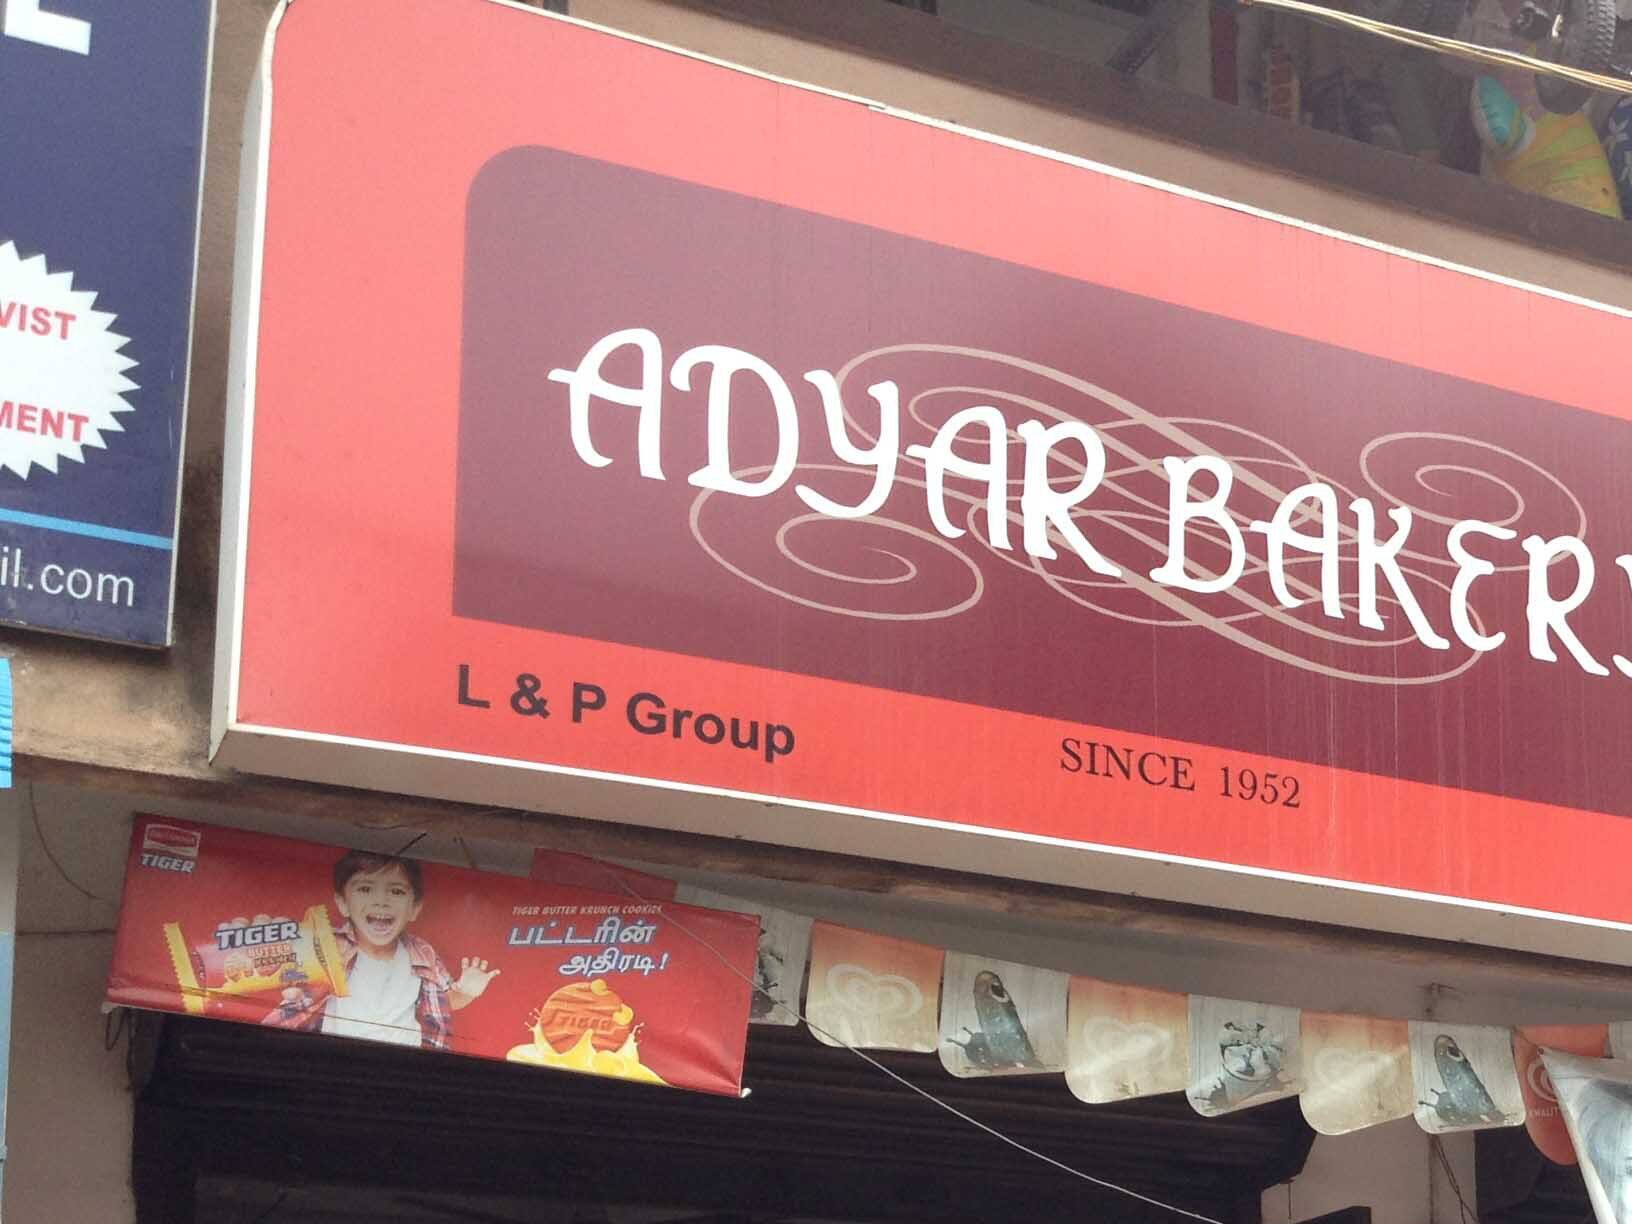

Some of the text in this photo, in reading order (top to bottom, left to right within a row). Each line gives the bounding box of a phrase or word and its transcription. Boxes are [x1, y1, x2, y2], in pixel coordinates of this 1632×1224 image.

[548, 328, 1122, 579] ADYAR
[457, 664, 796, 763] L & P Group
[1060, 738, 1302, 810] SINCE 1952
[141, 853, 196, 874] TIGER
[215, 920, 302, 951] TIGER
[511, 905, 540, 916] TIGER
